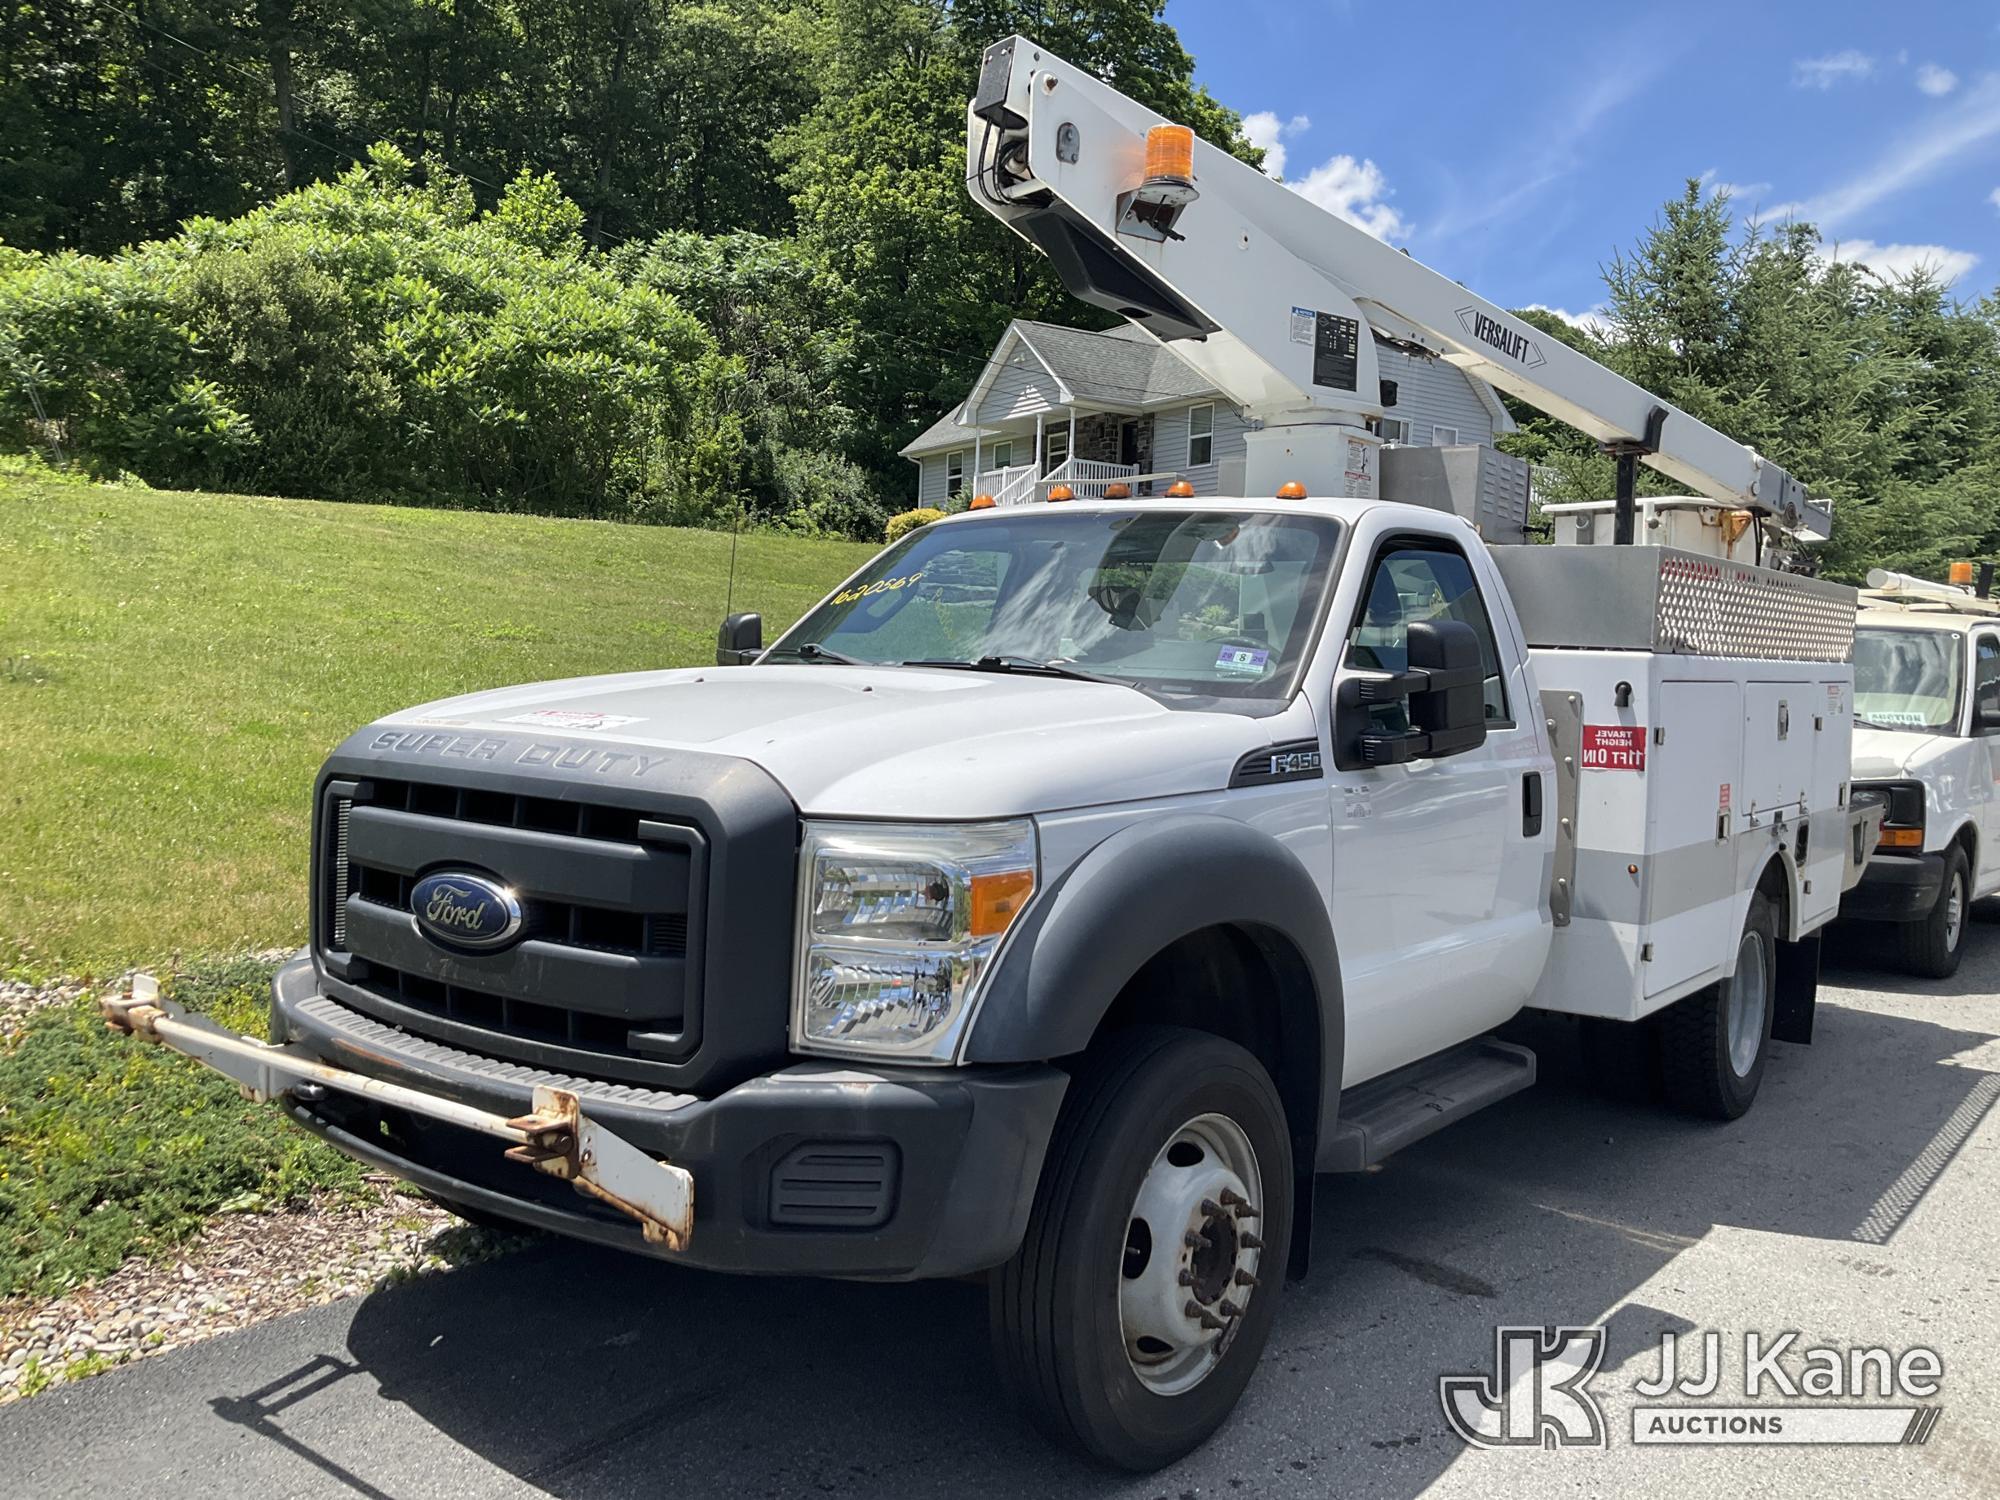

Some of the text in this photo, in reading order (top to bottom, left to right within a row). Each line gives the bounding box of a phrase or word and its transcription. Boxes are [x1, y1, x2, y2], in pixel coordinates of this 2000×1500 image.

[1474, 311, 1529, 363] VERSALIFT
[369, 732, 672, 777] SUPER DUTY
[427, 884, 485, 930] Ford
